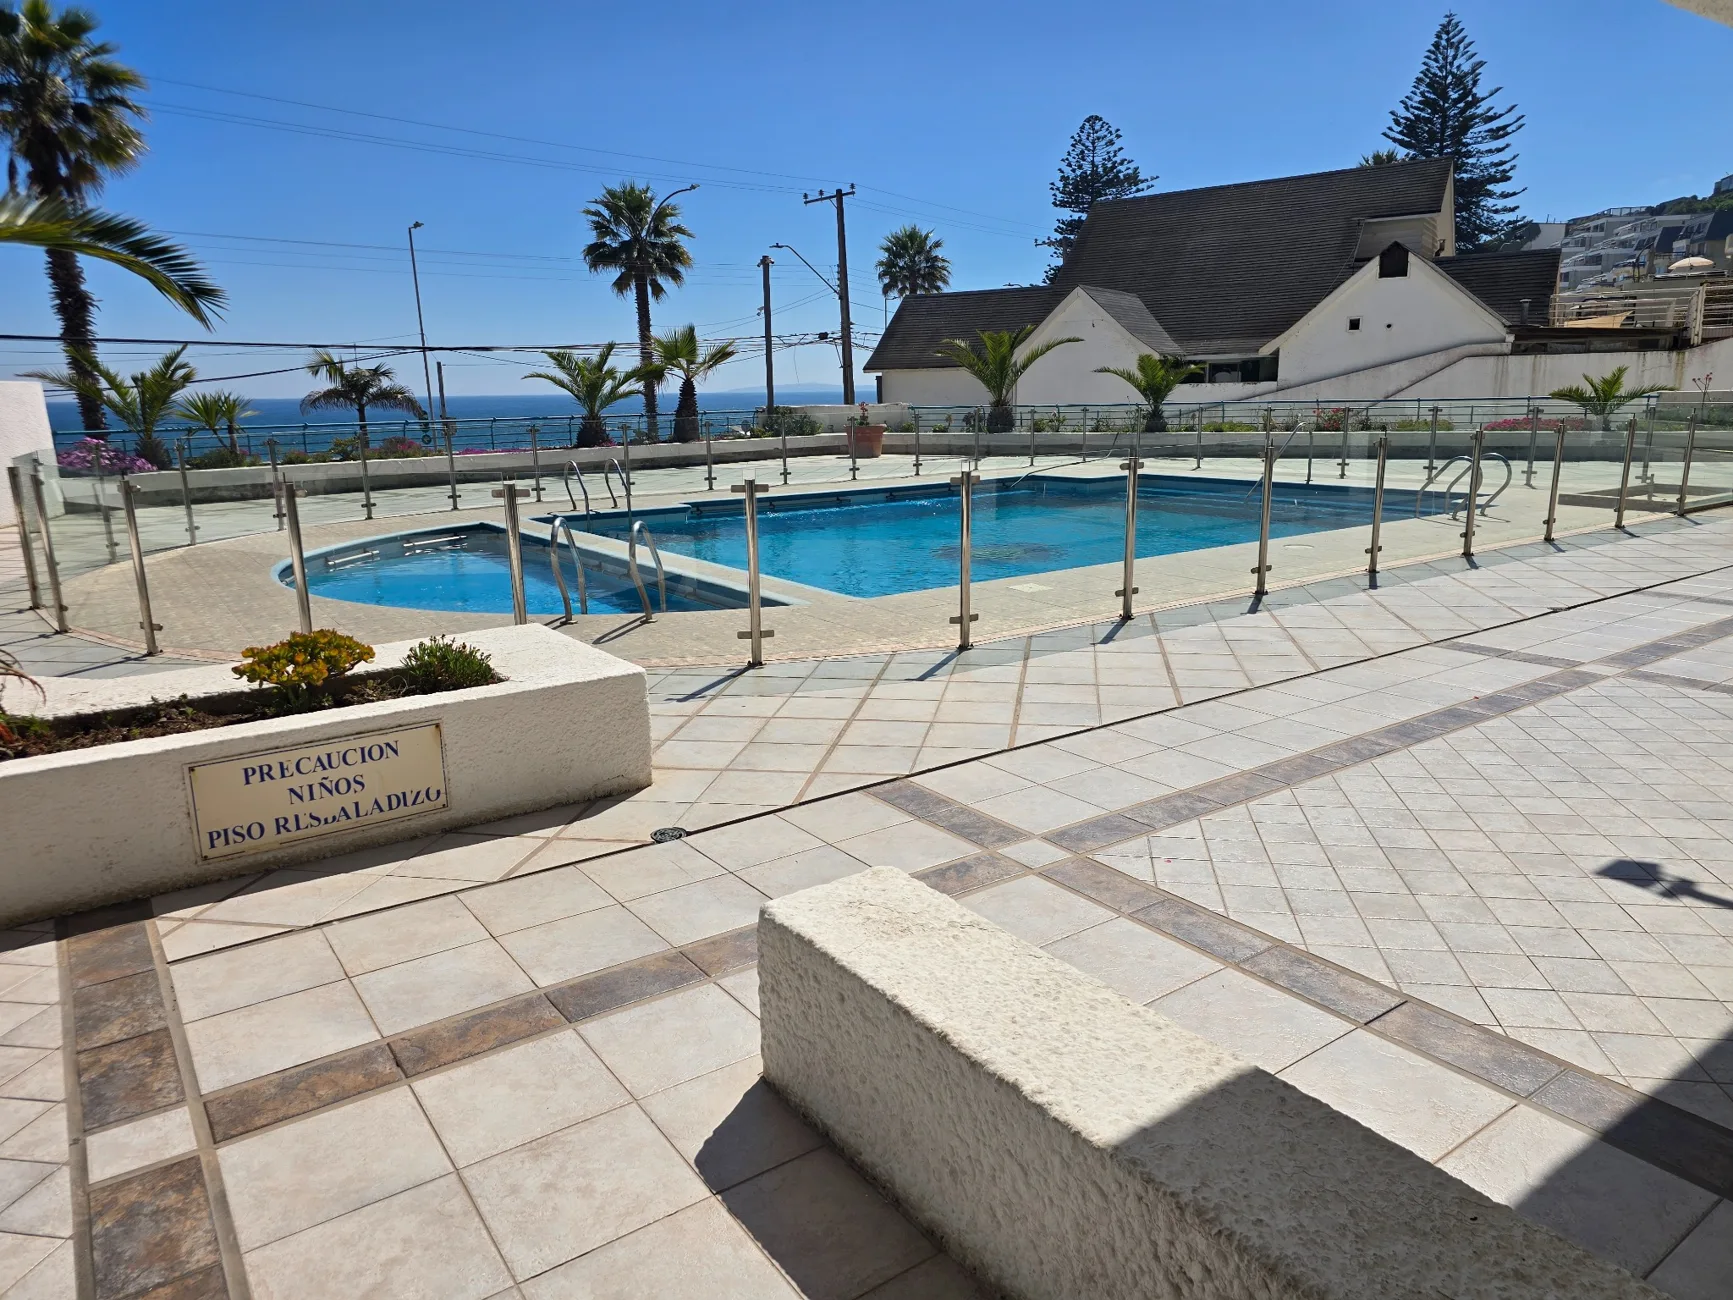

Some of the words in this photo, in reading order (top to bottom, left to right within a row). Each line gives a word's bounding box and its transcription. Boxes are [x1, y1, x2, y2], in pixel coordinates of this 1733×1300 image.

[242, 740, 400, 786] PRECAUCION
[288, 774, 366, 805] NIÑOS
[208, 821, 265, 850] PISO
